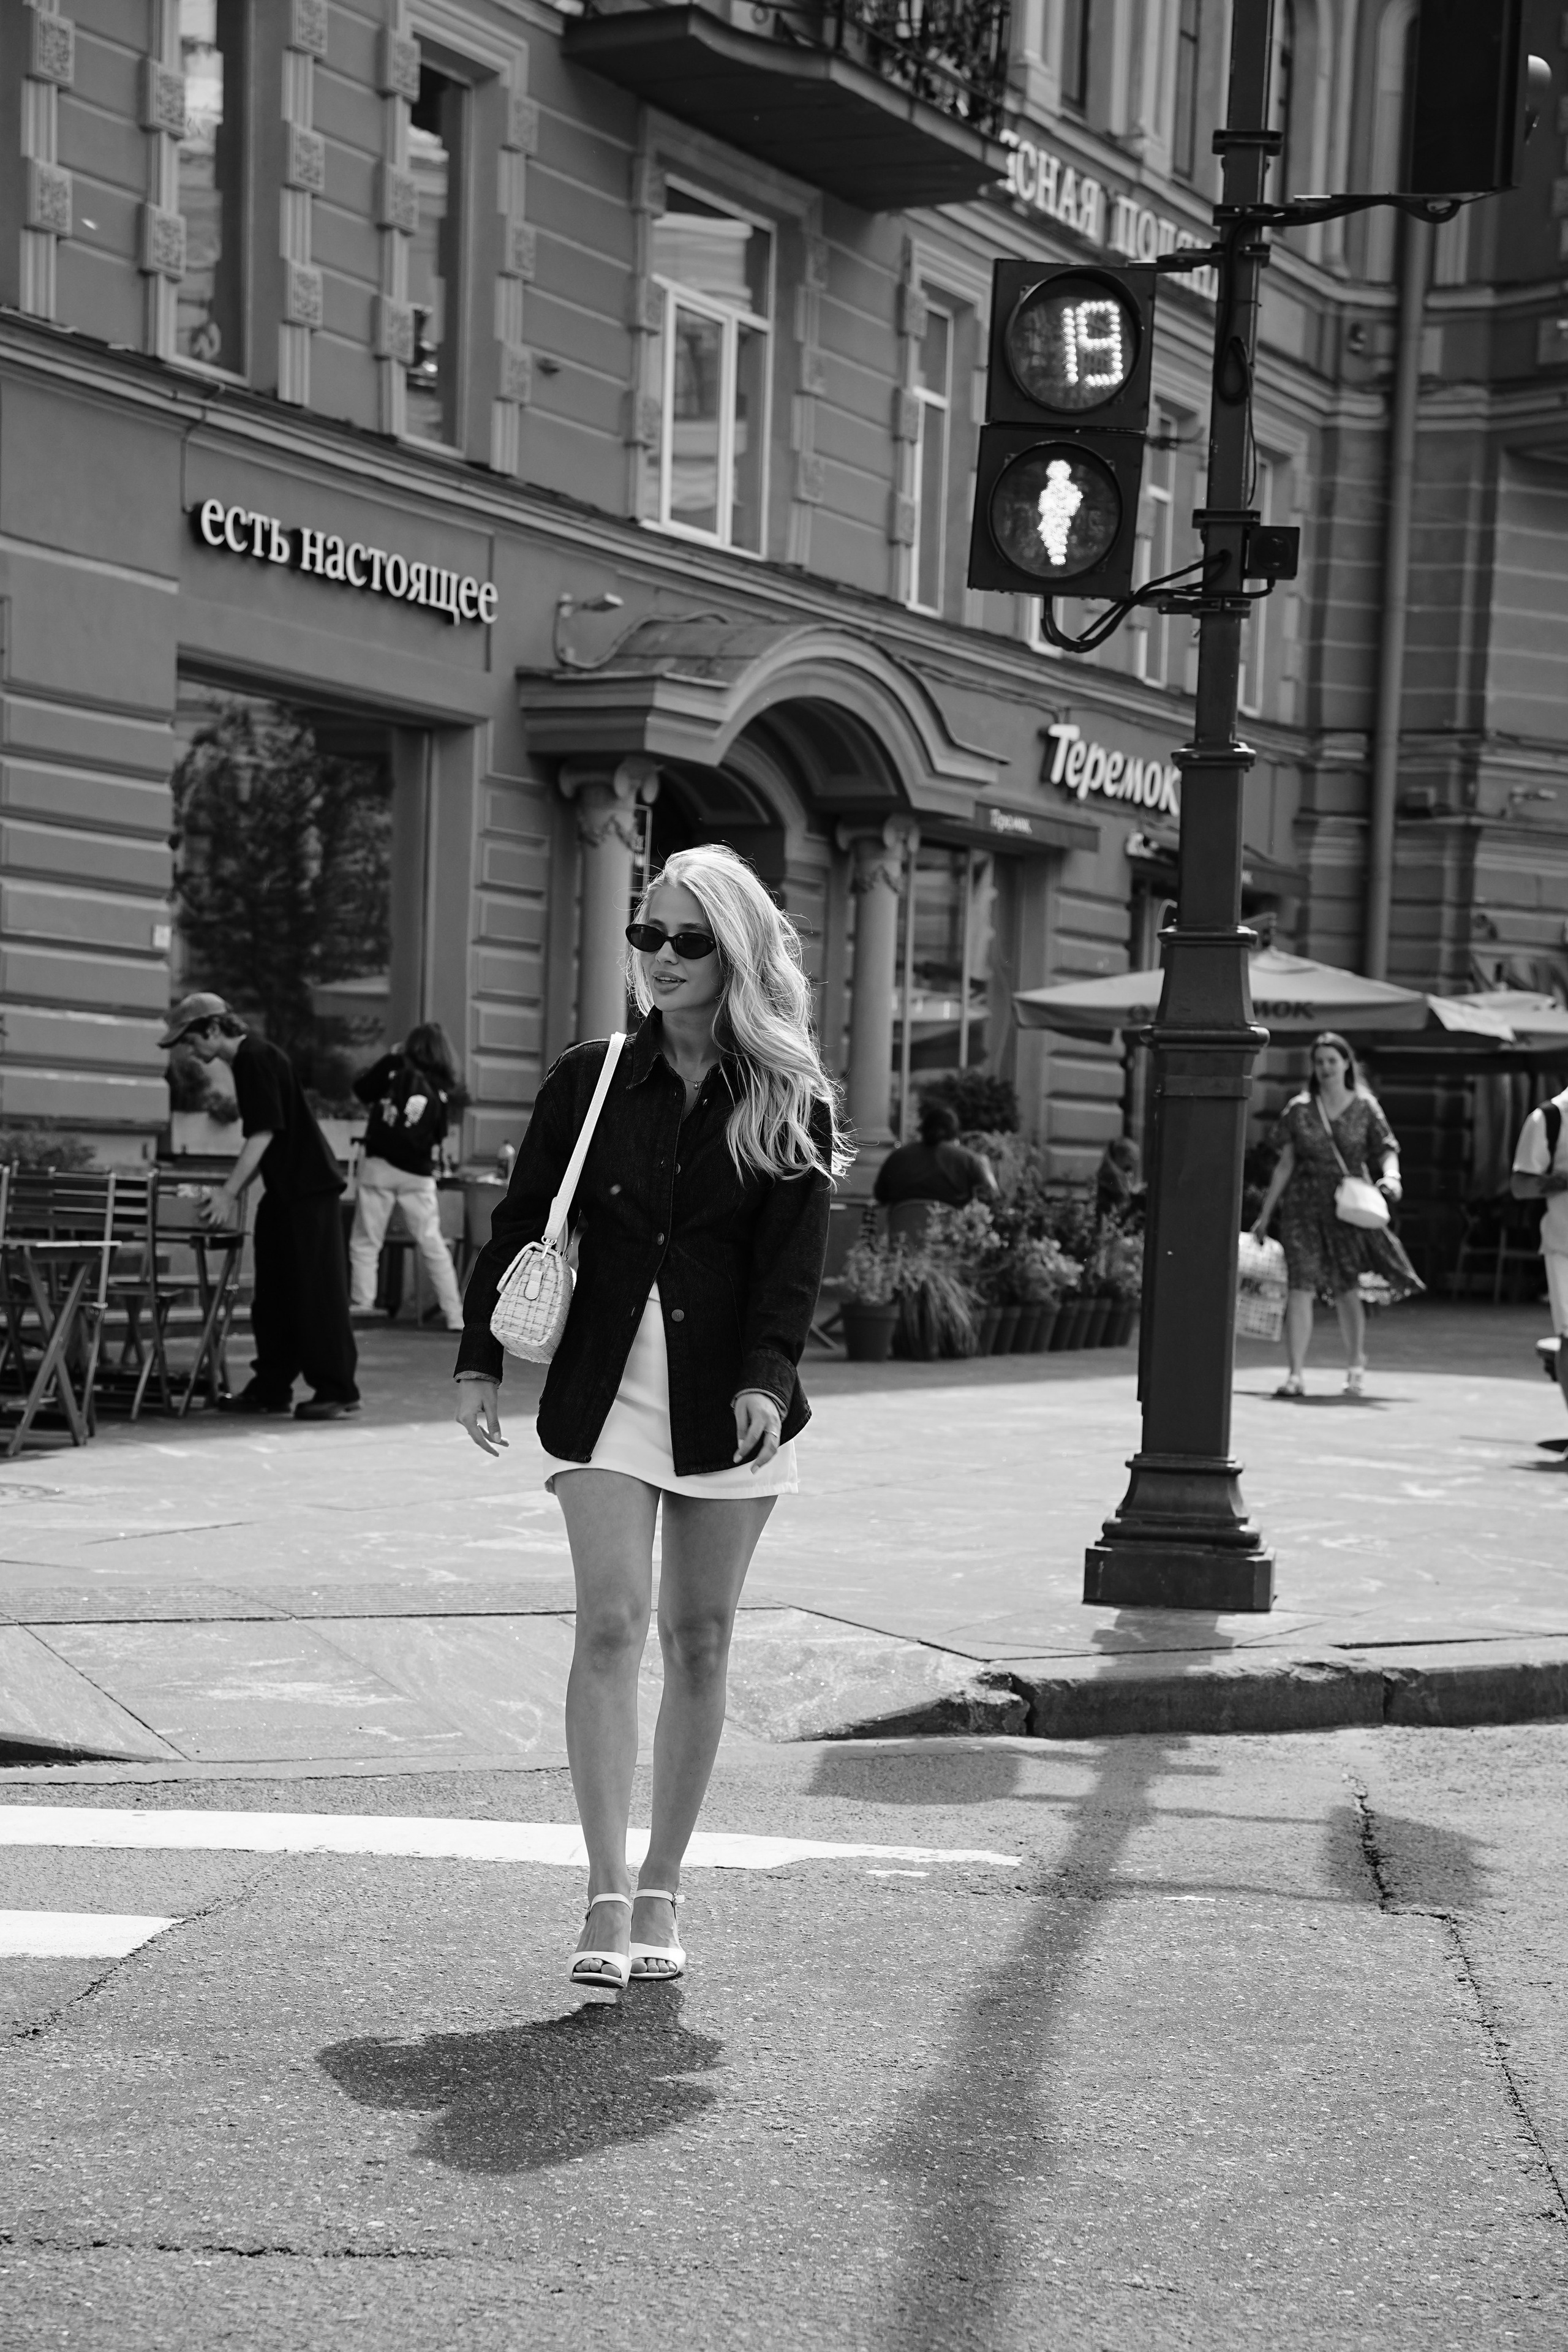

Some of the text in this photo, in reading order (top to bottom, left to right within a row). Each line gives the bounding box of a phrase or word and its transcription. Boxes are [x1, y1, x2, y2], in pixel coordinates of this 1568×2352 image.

[1061, 300, 1123, 388] 19
[201, 499, 499, 627] есть настоящее
[1048, 723, 1182, 817] Теремок
